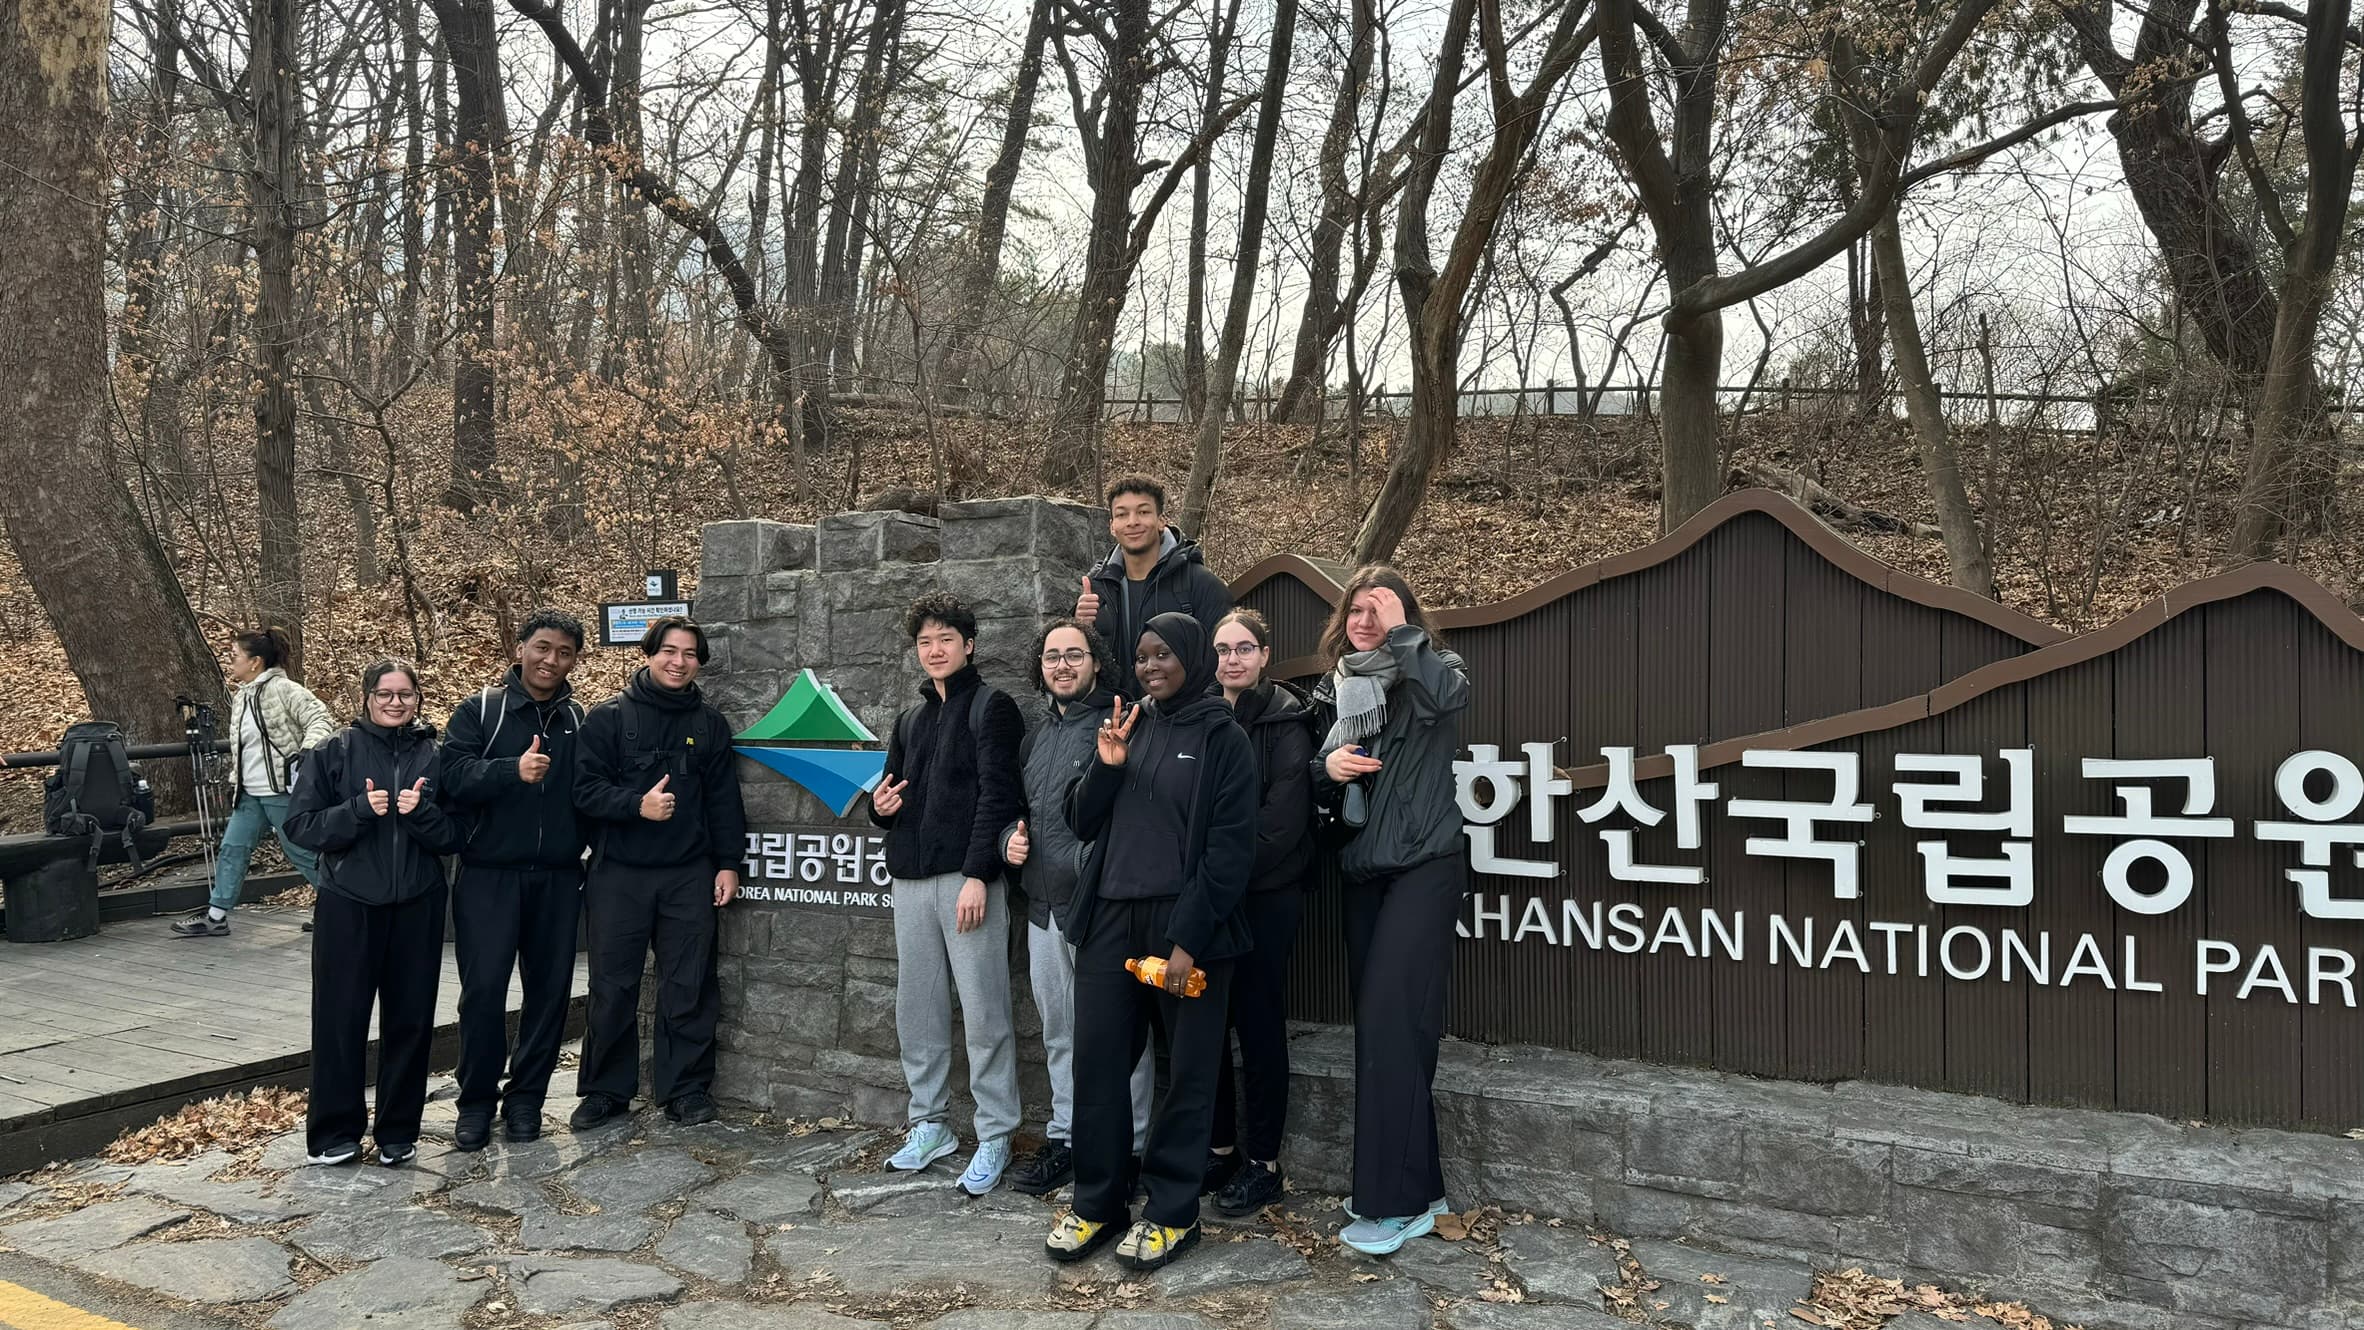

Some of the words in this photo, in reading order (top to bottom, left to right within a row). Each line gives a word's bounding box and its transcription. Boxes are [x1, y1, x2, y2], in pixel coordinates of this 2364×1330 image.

[774, 887, 841, 905] NATIONAL
[843, 891, 879, 907] PARK
[1769, 914, 2163, 993] NATIONAL
[2196, 939, 2358, 1008] PAR
